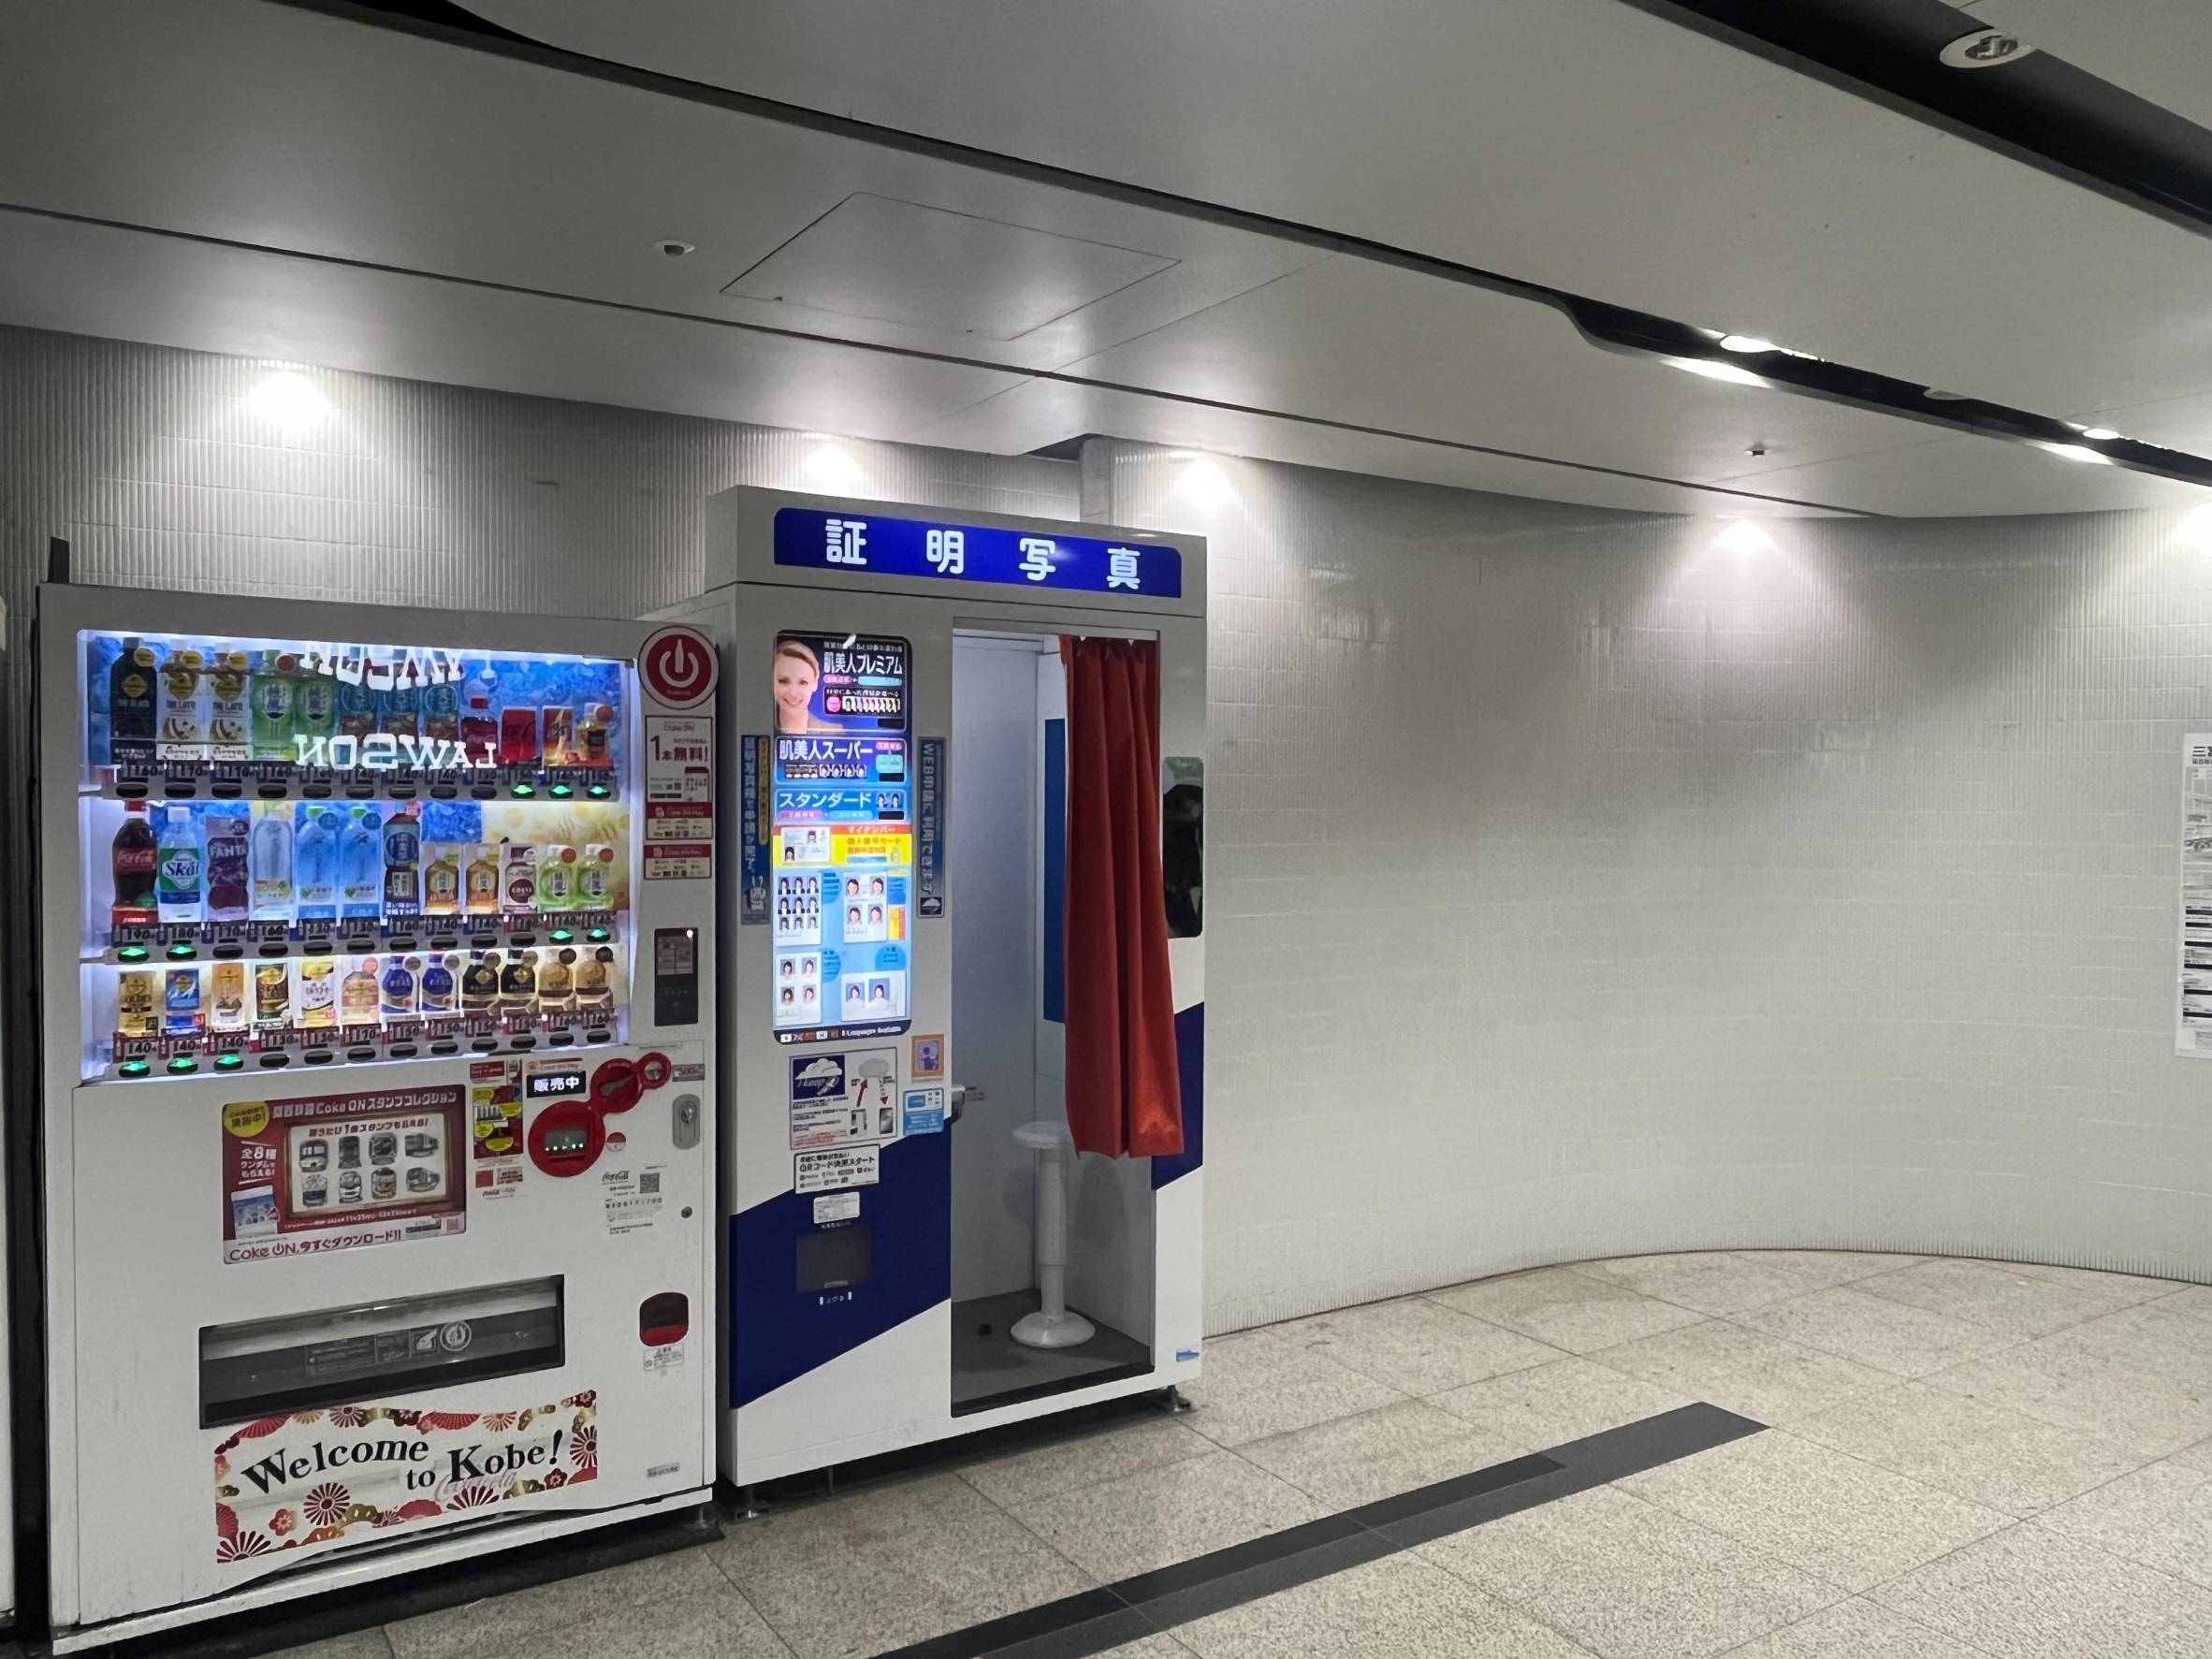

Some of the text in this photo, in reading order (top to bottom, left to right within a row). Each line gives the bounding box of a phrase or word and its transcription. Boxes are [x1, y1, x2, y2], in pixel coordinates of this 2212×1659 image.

[824, 518, 1142, 590] 証明写真
[823, 651, 903, 675] 肌美人プレミアム
[779, 739, 873, 761] 肌美人スーパー
[779, 792, 871, 808] スタンダード
[533, 1076, 579, 1093] 販売中
[240, 1440, 429, 1496] Welcome
[405, 1429, 564, 1492] to Kobe!
